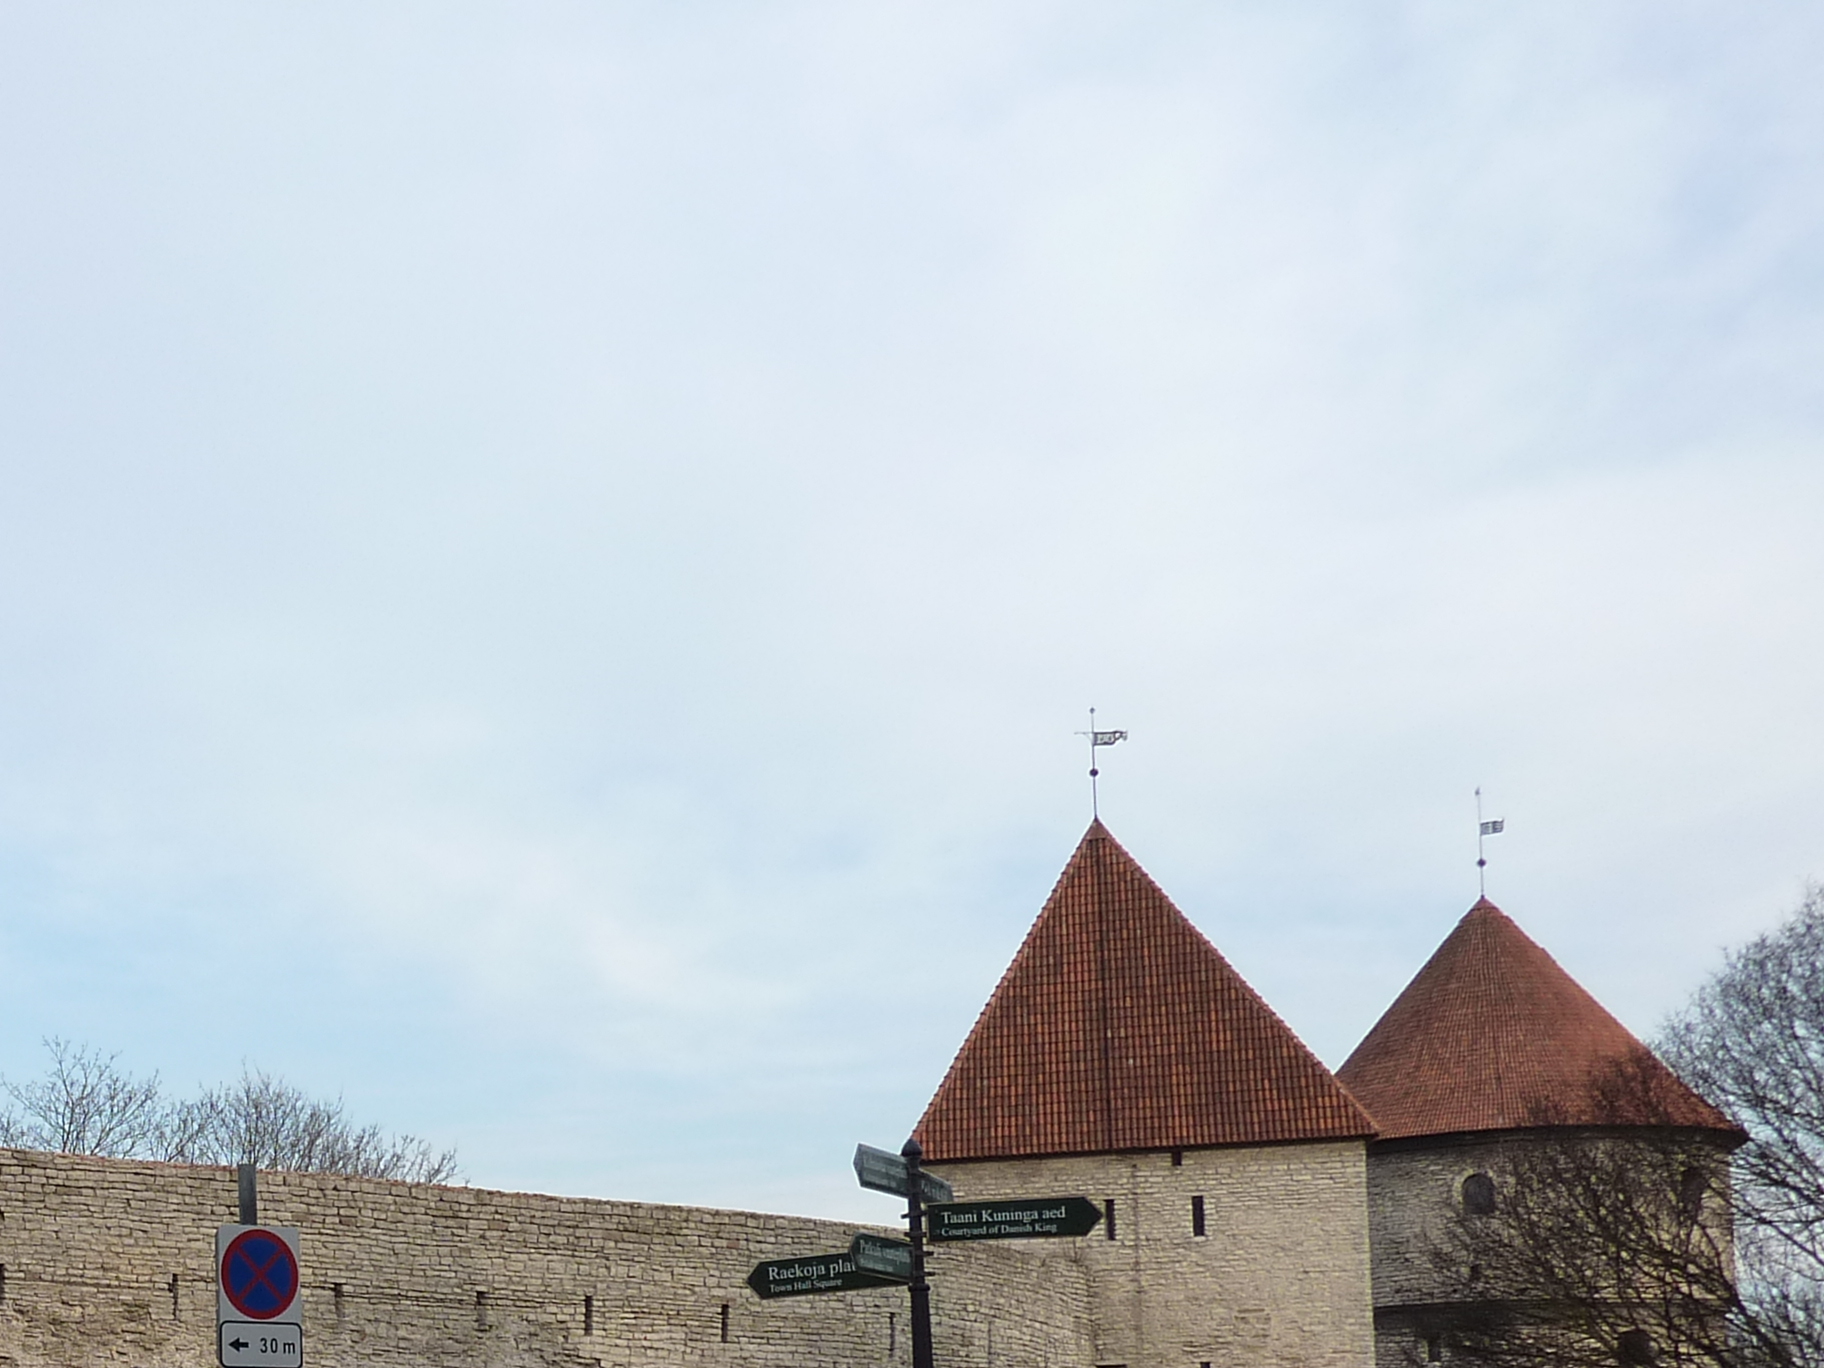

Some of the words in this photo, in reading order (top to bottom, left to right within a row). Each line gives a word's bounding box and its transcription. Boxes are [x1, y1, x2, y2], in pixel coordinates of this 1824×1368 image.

[941, 1211, 977, 1224] Taani
[981, 1208, 1039, 1223] Kuninga
[1042, 1205, 1066, 1219] aed
[941, 1225, 987, 1238] Courtyard
[988, 1225, 1000, 1234] of
[1001, 1222, 1033, 1234] Danish
[1034, 1221, 1058, 1235] King
[768, 1261, 826, 1281] Raekoja
[770, 1282, 792, 1294] Town
[793, 1279, 812, 1291] Hall
[813, 1277, 843, 1290] Square
[259, 1337, 279, 1354] 30
[283, 1342, 296, 1355] m
